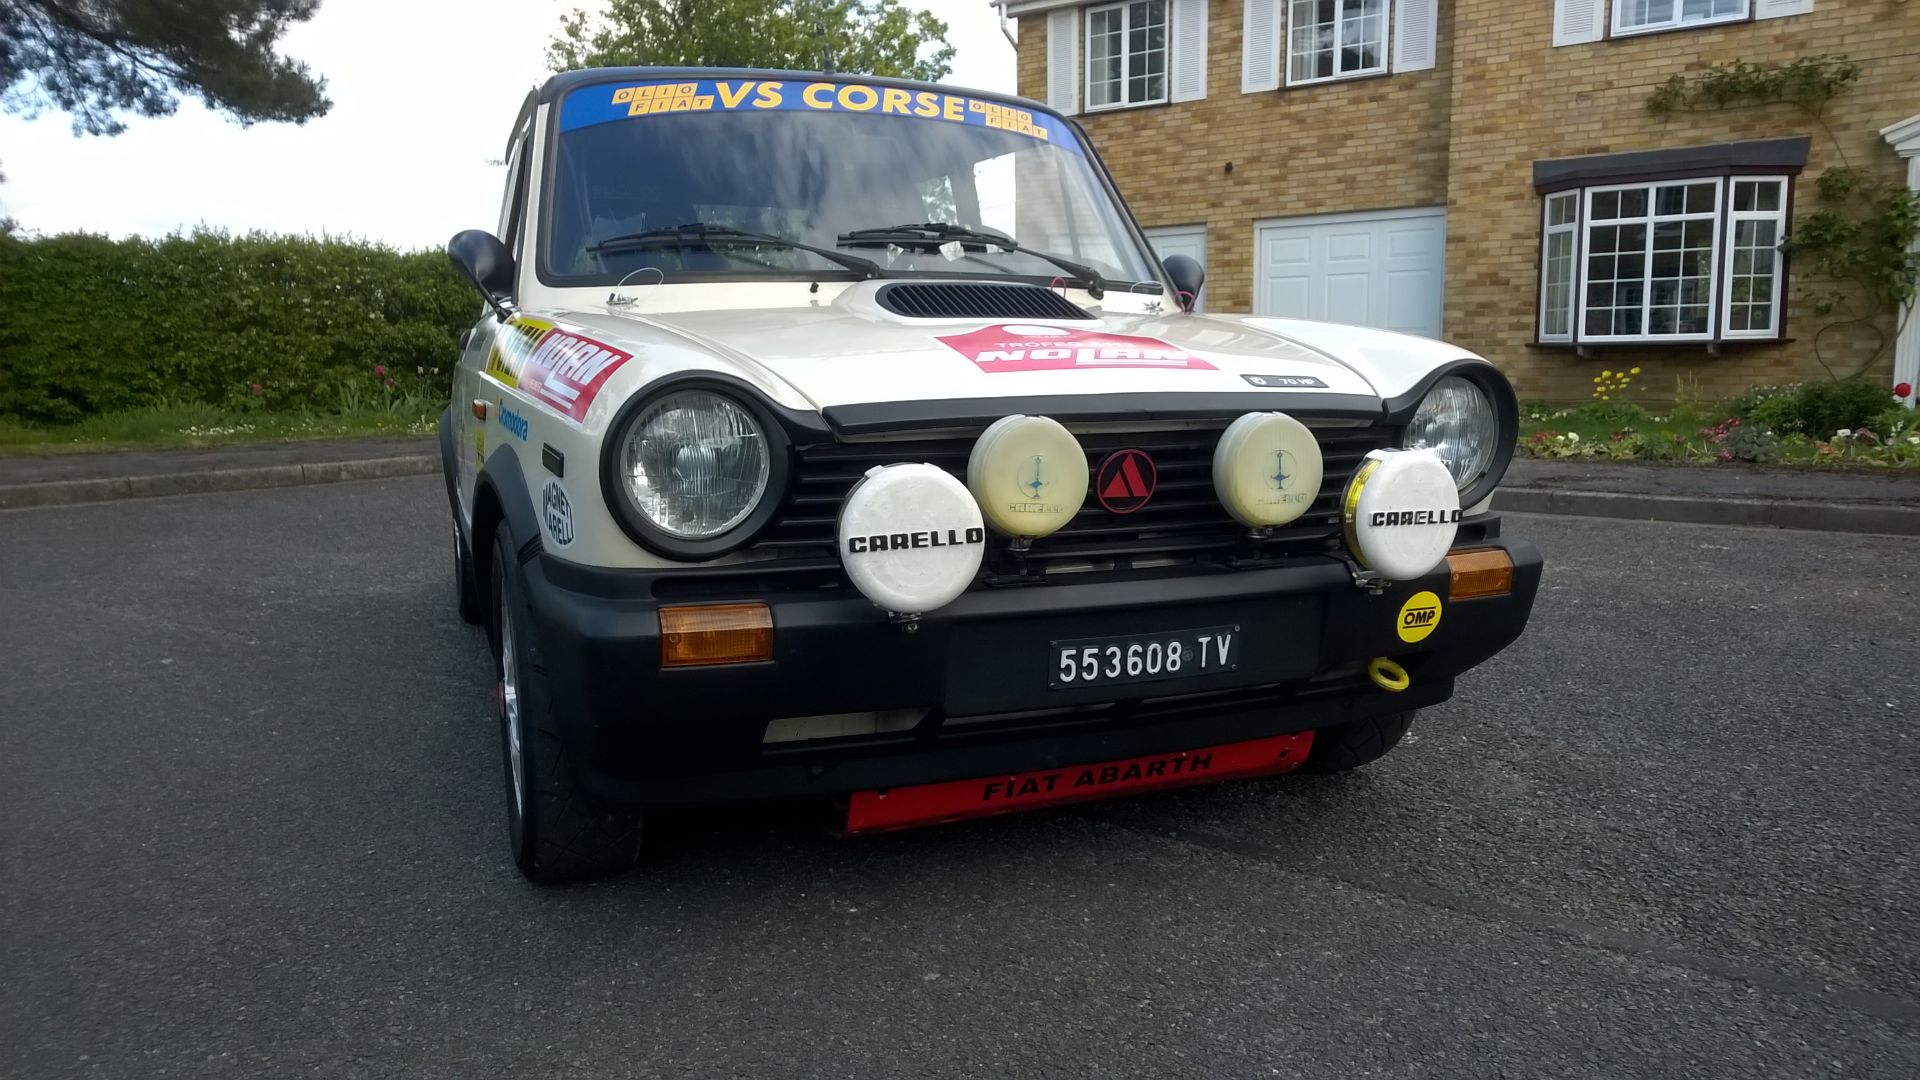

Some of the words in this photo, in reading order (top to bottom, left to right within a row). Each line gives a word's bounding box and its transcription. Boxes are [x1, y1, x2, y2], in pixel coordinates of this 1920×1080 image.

[616, 85, 694, 102] OLIO
[716, 81, 784, 108] VS
[802, 82, 965, 121] CORSE
[633, 98, 710, 113] FIAT
[971, 101, 1031, 121] OLIO
[988, 117, 1044, 137] FIAT
[532, 333, 622, 401] NOLAN
[975, 348, 1188, 366] NOLAN
[1370, 508, 1463, 527] CARELLO
[848, 527, 984, 553] CARELLO
[1404, 609, 1436, 626] OMP
[1058, 640, 1183, 683] 553608
[1198, 633, 1232, 668] TV
[982, 773, 1063, 801] FIAT
[1073, 751, 1215, 788] ABARTH
